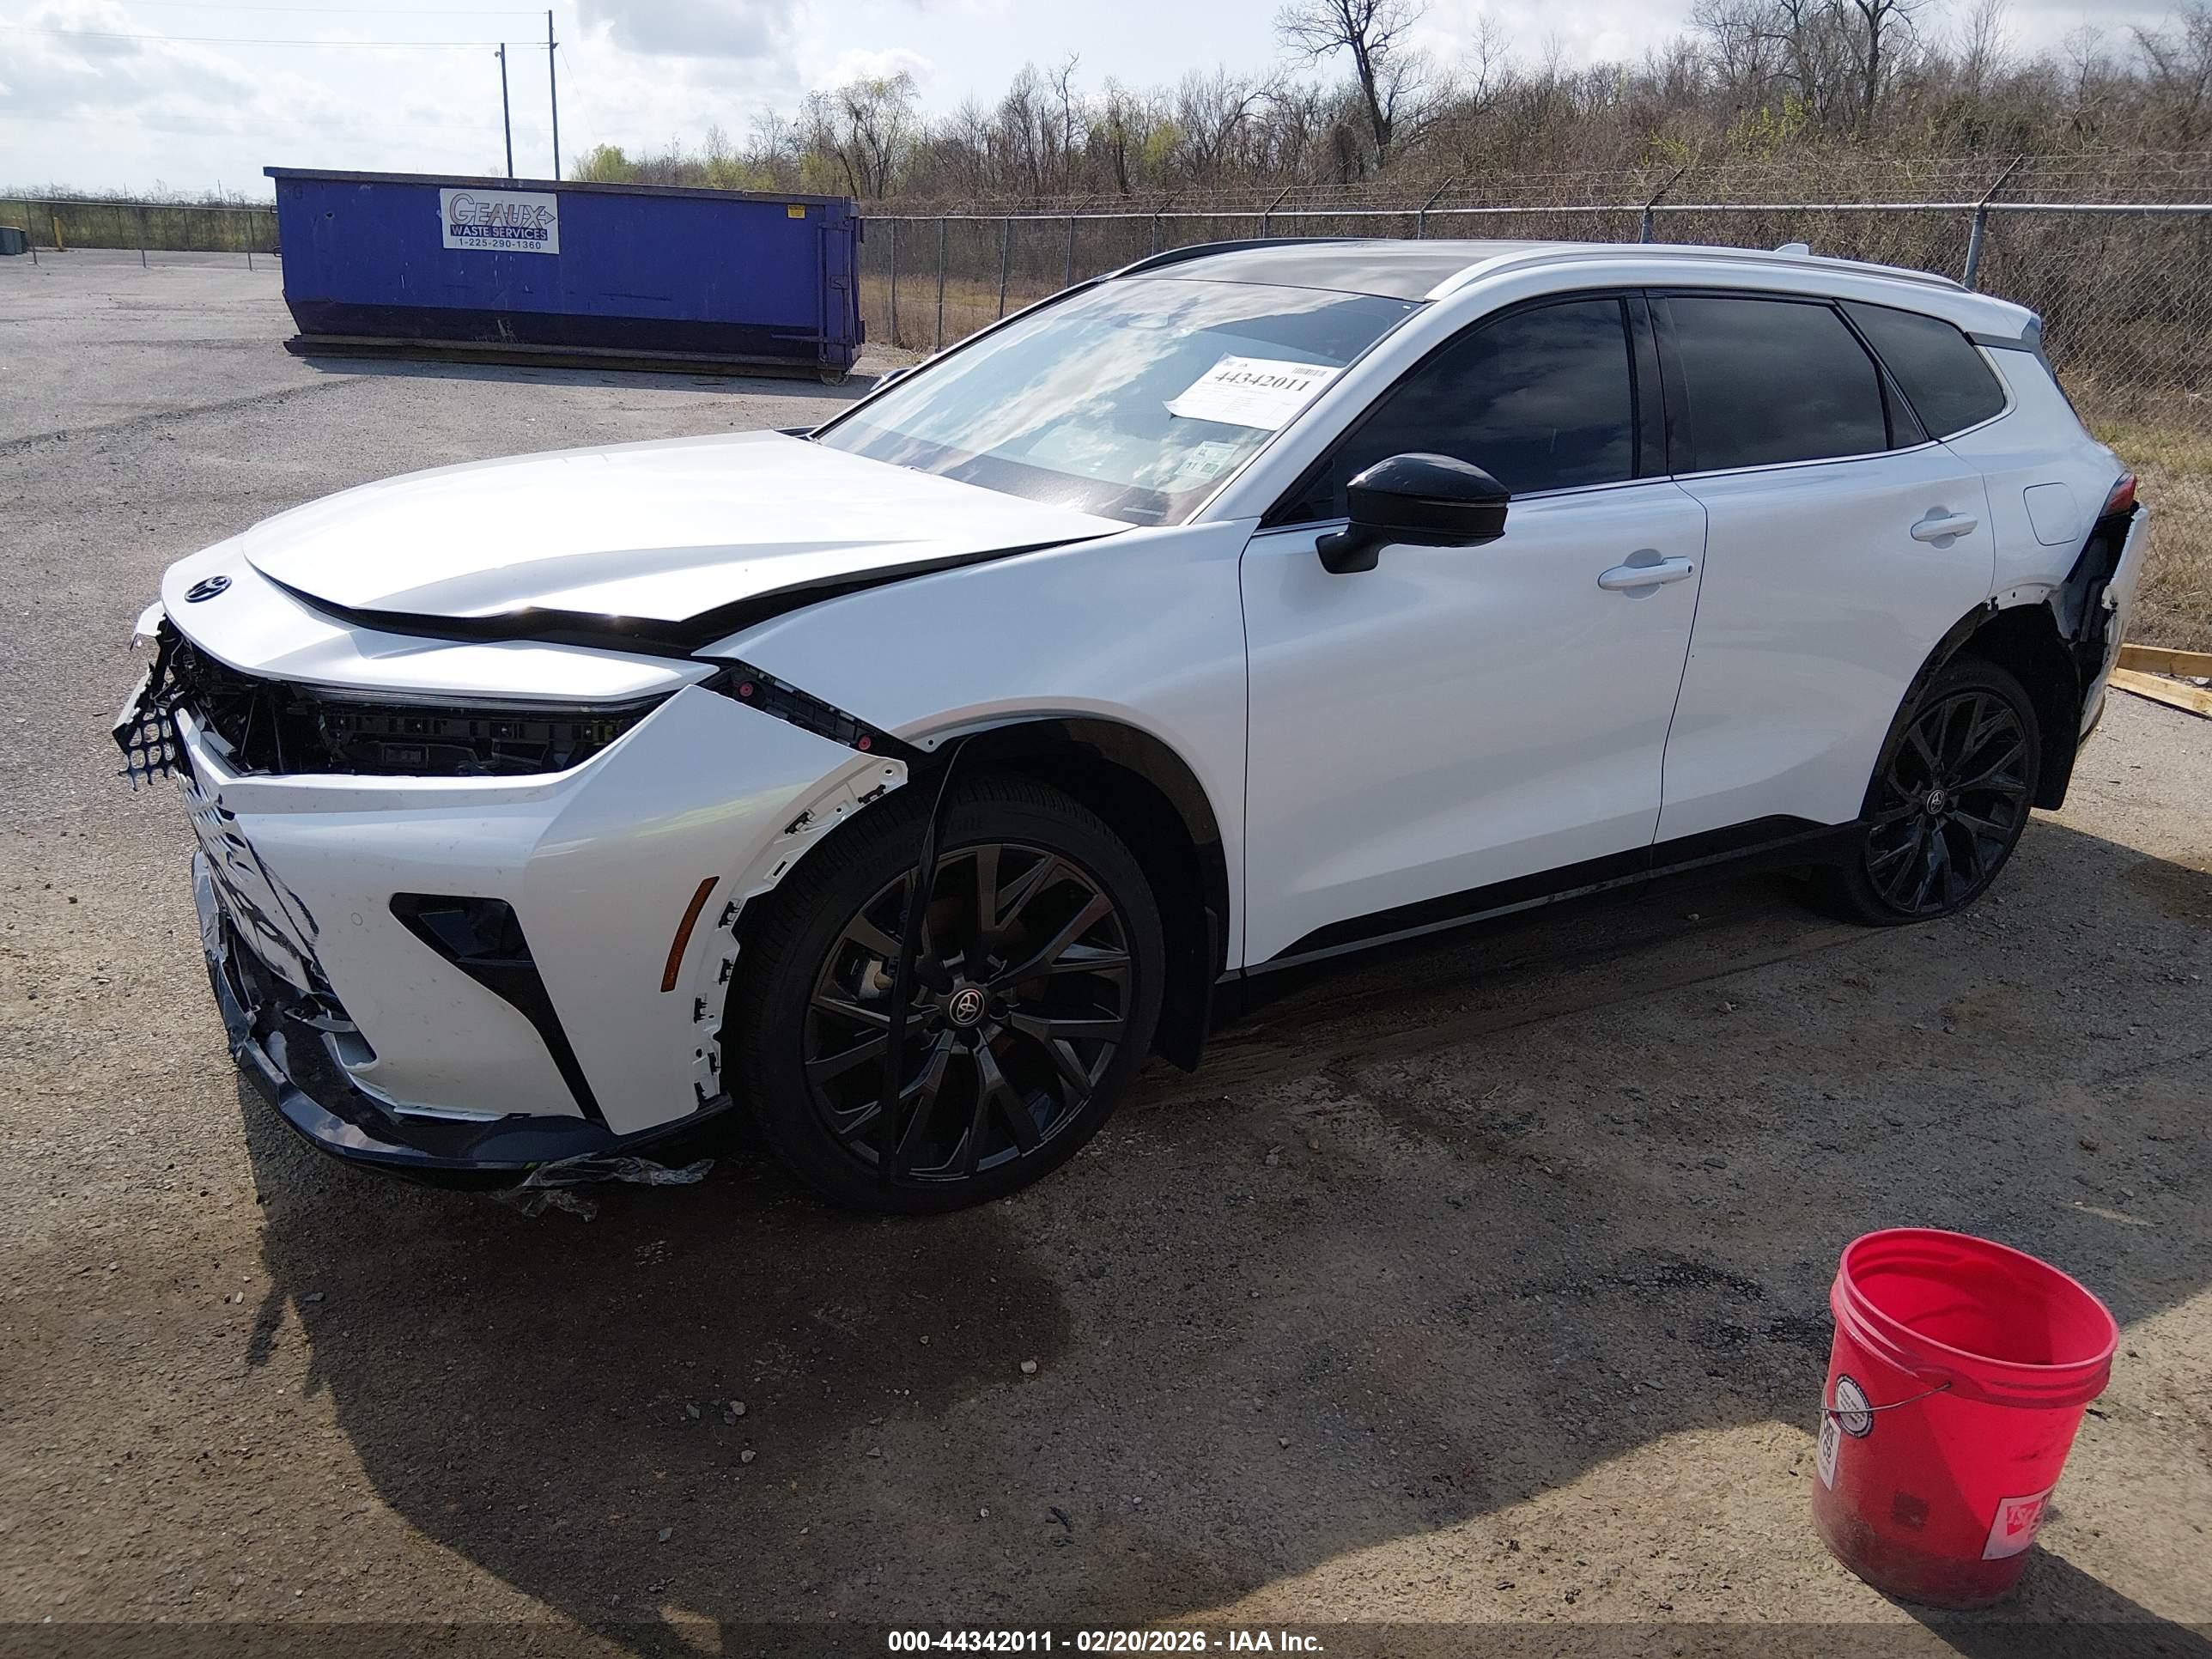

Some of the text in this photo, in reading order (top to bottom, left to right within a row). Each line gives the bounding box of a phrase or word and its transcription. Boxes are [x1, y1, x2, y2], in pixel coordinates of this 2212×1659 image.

[449, 193, 544, 229] GEAUX
[452, 226, 547, 240] WASTE SERVICES
[459, 238, 542, 250] 1-225-290-1360
[1215, 371, 1311, 392] 44342011
